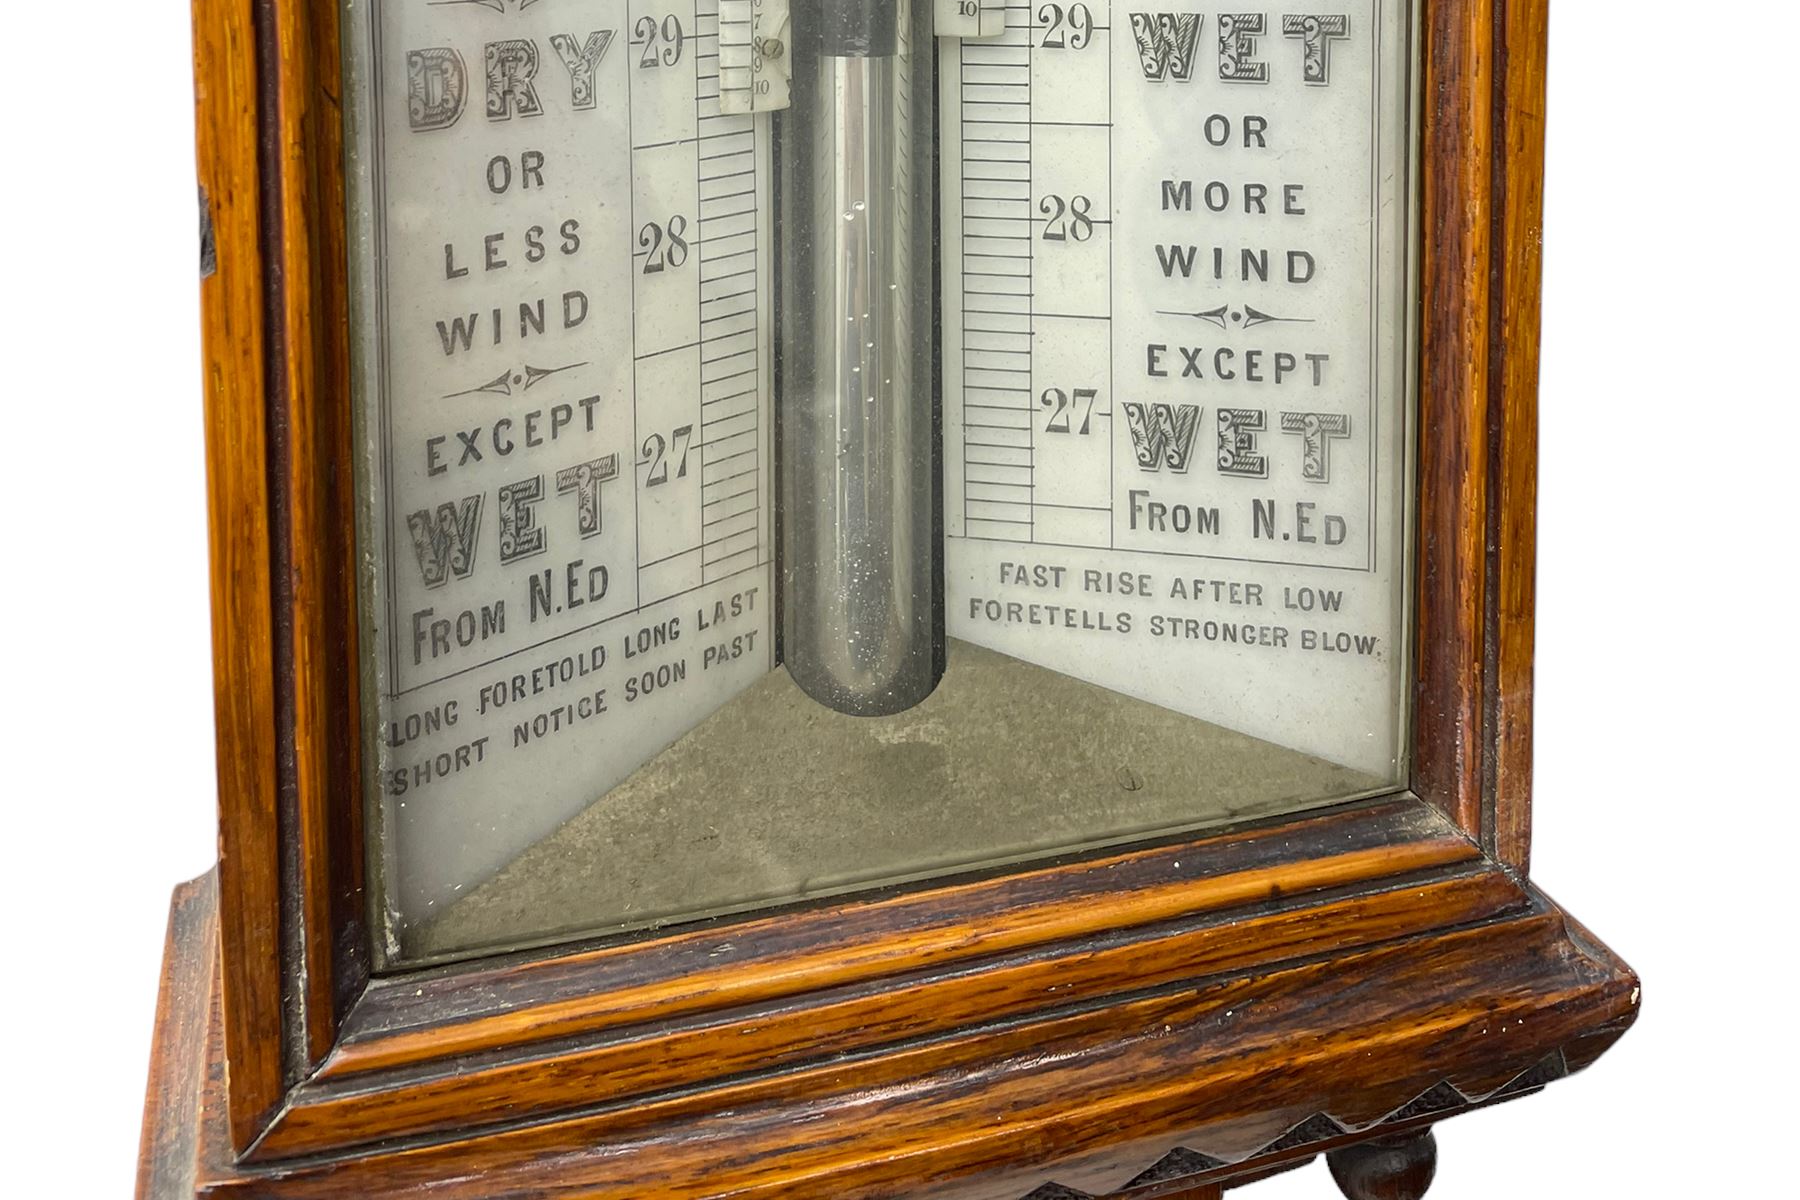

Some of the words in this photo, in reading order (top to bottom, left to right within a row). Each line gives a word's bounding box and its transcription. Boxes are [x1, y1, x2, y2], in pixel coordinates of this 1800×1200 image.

[754, 14, 762, 30] 7
[957, 1, 978, 16] 10
[1038, 3, 1093, 50] 29
[634, 14, 684, 69] 29
[753, 37, 762, 51] 8
[753, 57, 763, 73] 9
[1129, 12, 1351, 86] WET
[406, 28, 617, 133] DRY
[754, 79, 769, 95] 10
[1204, 115, 1268, 148] OR
[486, 150, 545, 194] OR
[1162, 180, 1306, 215] MORE
[1039, 195, 1094, 242] 28
[444, 219, 580, 280] LESS
[638, 214, 688, 275] 28
[1155, 244, 1316, 284] WIND
[436, 290, 589, 356] WIND
[1147, 343, 1329, 387] EXCEPT
[427, 395, 600, 477] EXCEPT
[1040, 388, 1097, 435] 27
[641, 424, 693, 488] 27
[1122, 402, 1351, 484] WET
[407, 451, 619, 590] WET
[1129, 490, 1220, 536] FROM
[1000, 562, 1066, 589] FAST
[1084, 570, 1153, 598] RISE
[1170, 577, 1263, 606] AFTER
[1284, 587, 1343, 613] LOW
[412, 600, 506, 665] FROM
[969, 598, 1132, 635] FORETELLS
[1150, 615, 1289, 649] STRONGER
[392, 700, 459, 747] LONG
[479, 645, 606, 716] FORETOLD
[624, 617, 680, 659] LONG
[698, 587, 759, 632] LAST
[389, 737, 489, 796] SHORT
[513, 688, 608, 748] NOTICE
[625, 659, 686, 702] SOON
[704, 630, 758, 670] PAST
